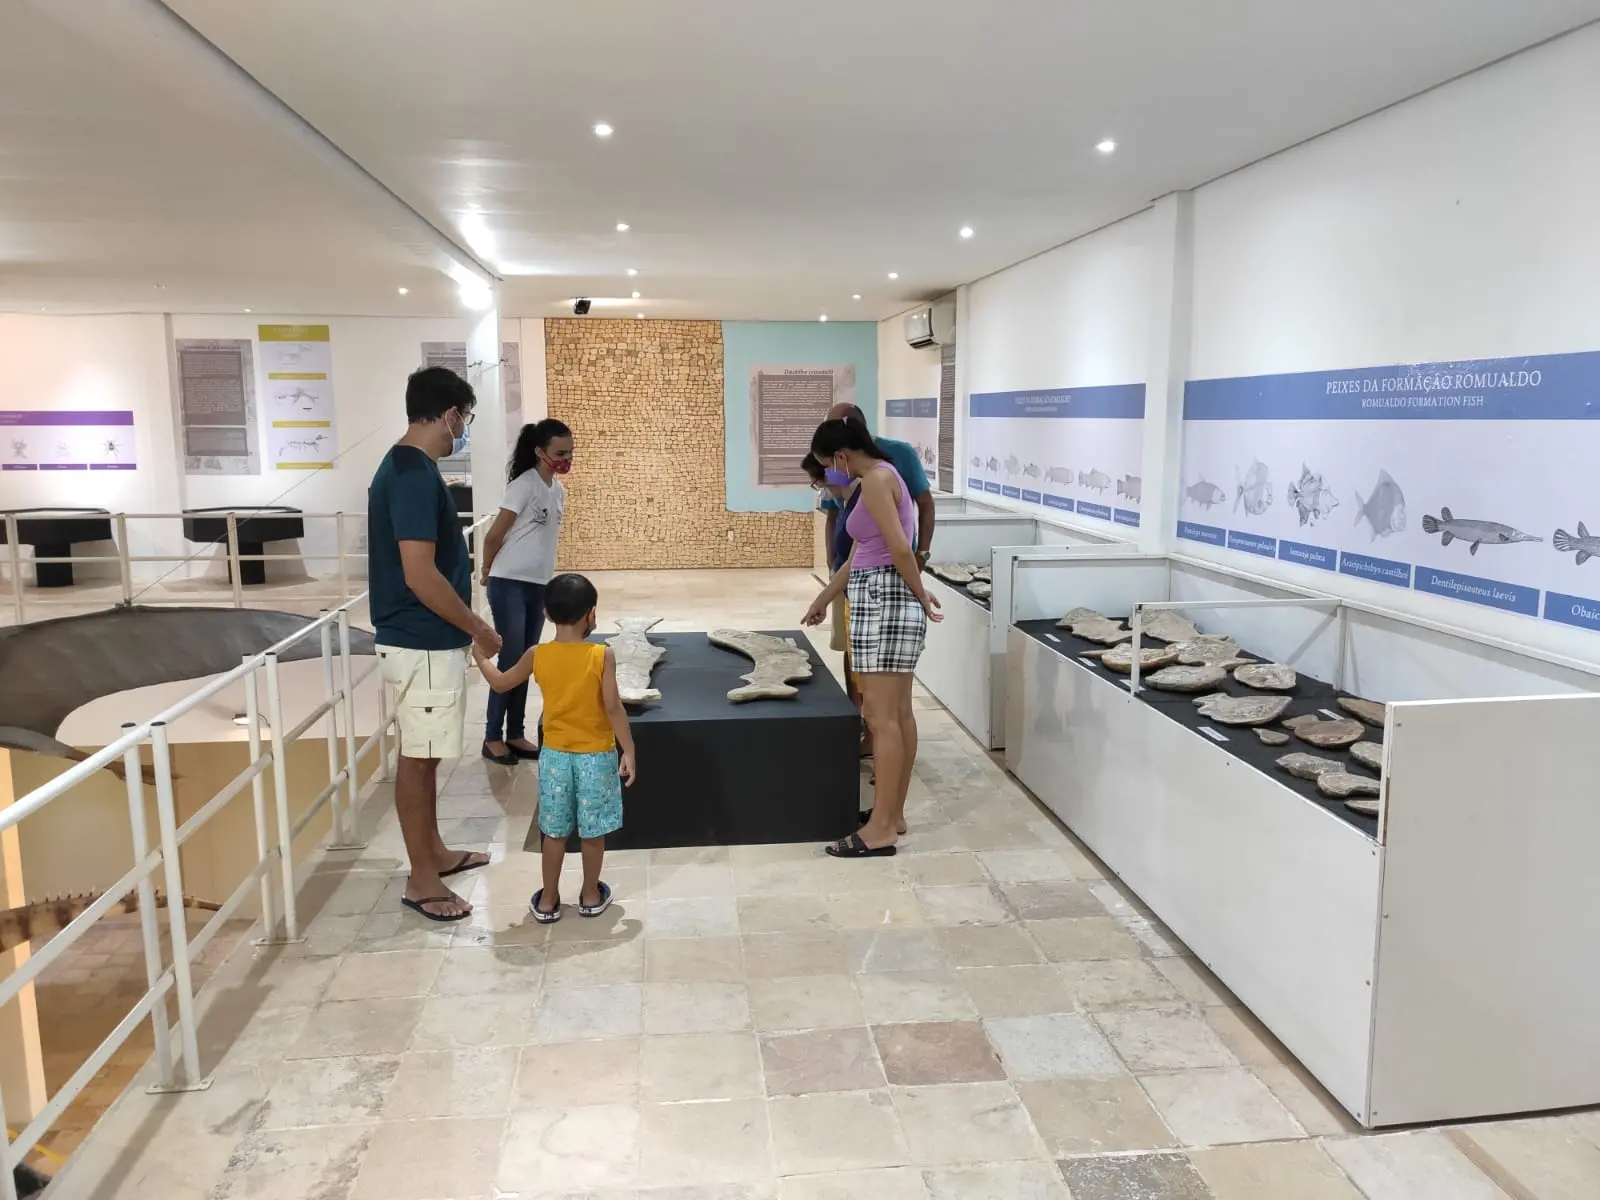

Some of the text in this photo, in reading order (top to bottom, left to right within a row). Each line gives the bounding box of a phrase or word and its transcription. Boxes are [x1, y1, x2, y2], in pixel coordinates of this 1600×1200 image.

[1326, 370, 1542, 394] PEIXES DA FORMAÇÃO ROMUALDO
[1361, 395, 1484, 408] ROMUALDO FORMATION FISH
[1431, 575, 1517, 602] Dentilepisosteus laevis
